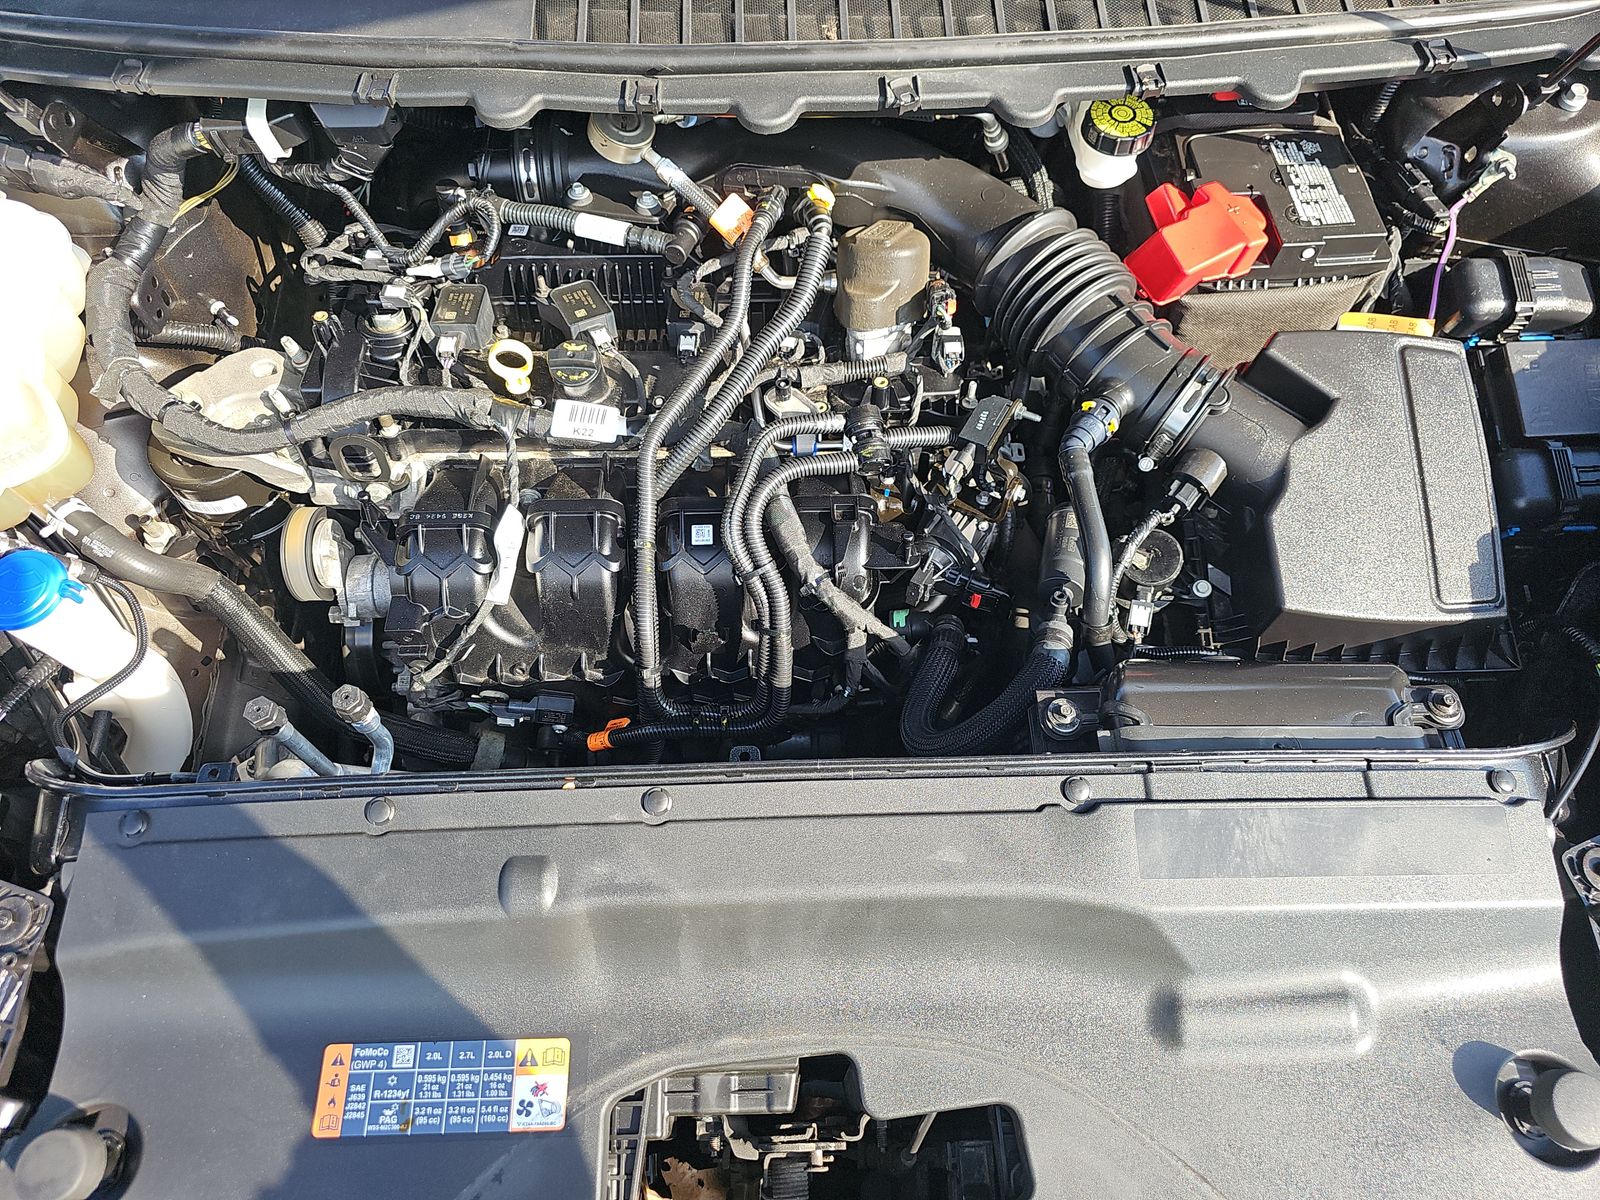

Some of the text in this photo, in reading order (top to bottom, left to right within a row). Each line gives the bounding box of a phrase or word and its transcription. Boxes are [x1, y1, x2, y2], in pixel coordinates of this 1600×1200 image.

[573, 427, 594, 437] K22
[354, 1048, 389, 1057] FoMoCo
[425, 1052, 442, 1060] 2.0L
[459, 1051, 475, 1059] 2.7L
[488, 1050, 512, 1059] 2.0L D
[351, 1060, 387, 1070] (GWP 4)
[418, 1074, 446, 1084] 0.595 kg
[451, 1074, 479, 1083] 0.595 kg
[484, 1073, 512, 1082] 0.454 kg
[350, 1084, 366, 1092] SAE
[347, 1093, 365, 1101] J639
[373, 1089, 410, 1099] R-1234yf
[345, 1102, 366, 1110] J2842
[414, 1107, 426, 1115] 3.2
[379, 1116, 397, 1124] PAG
[416, 1116, 440, 1125] (95 cc)
[450, 1116, 474, 1125] (95 cc)
[497, 1114, 508, 1123] cc)
